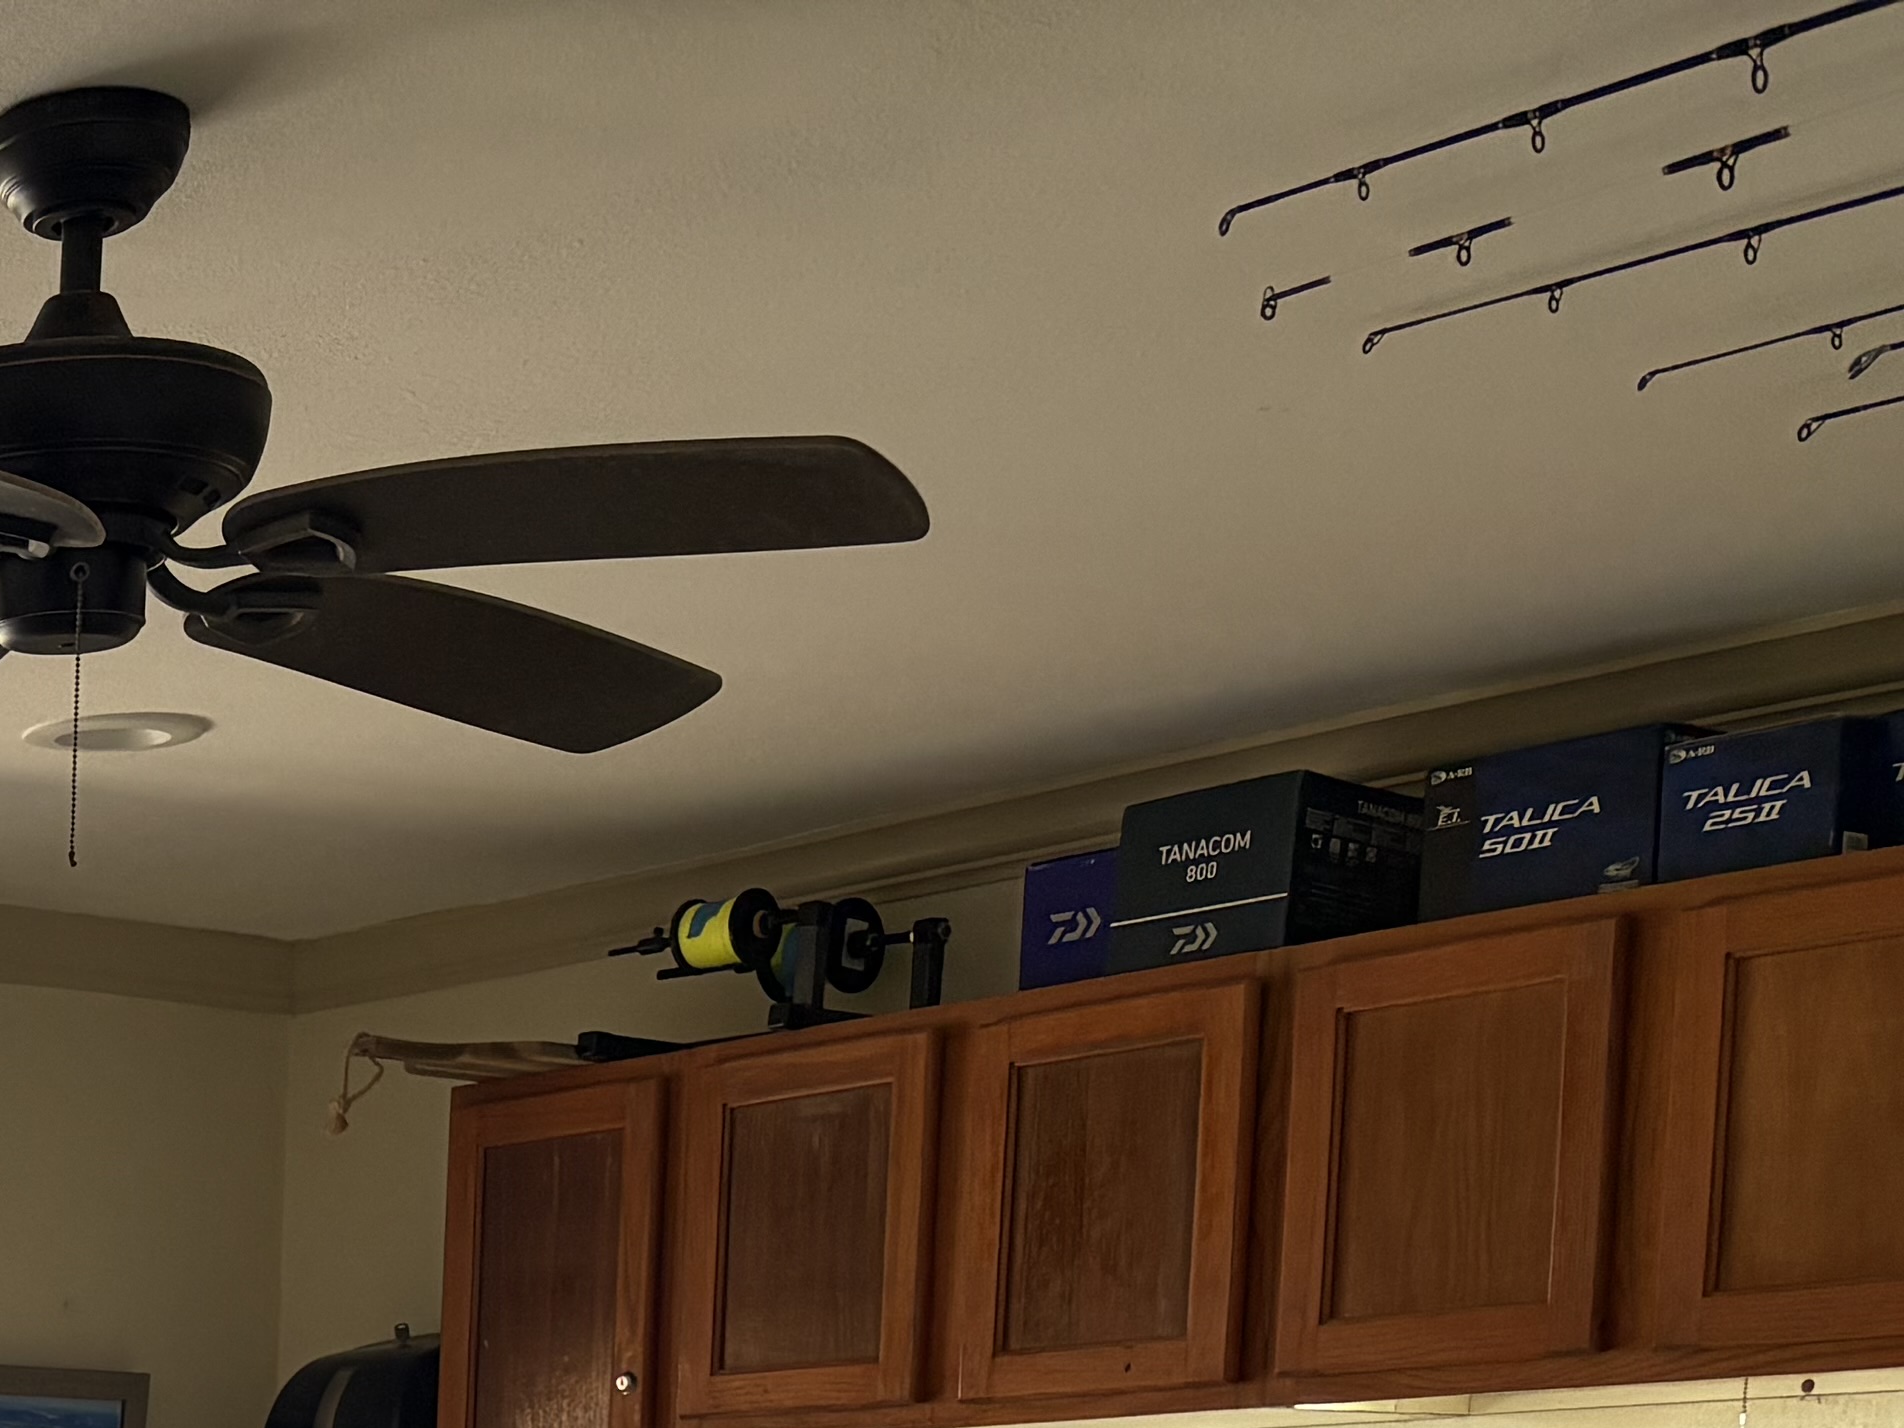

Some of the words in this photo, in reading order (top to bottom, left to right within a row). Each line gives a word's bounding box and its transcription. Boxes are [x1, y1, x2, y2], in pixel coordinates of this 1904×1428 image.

[1682, 770, 1812, 811] TALICA
[1480, 795, 1601, 834] TALICA
[1158, 830, 1251, 866] TANACOM
[1186, 862, 1217, 883] 800
